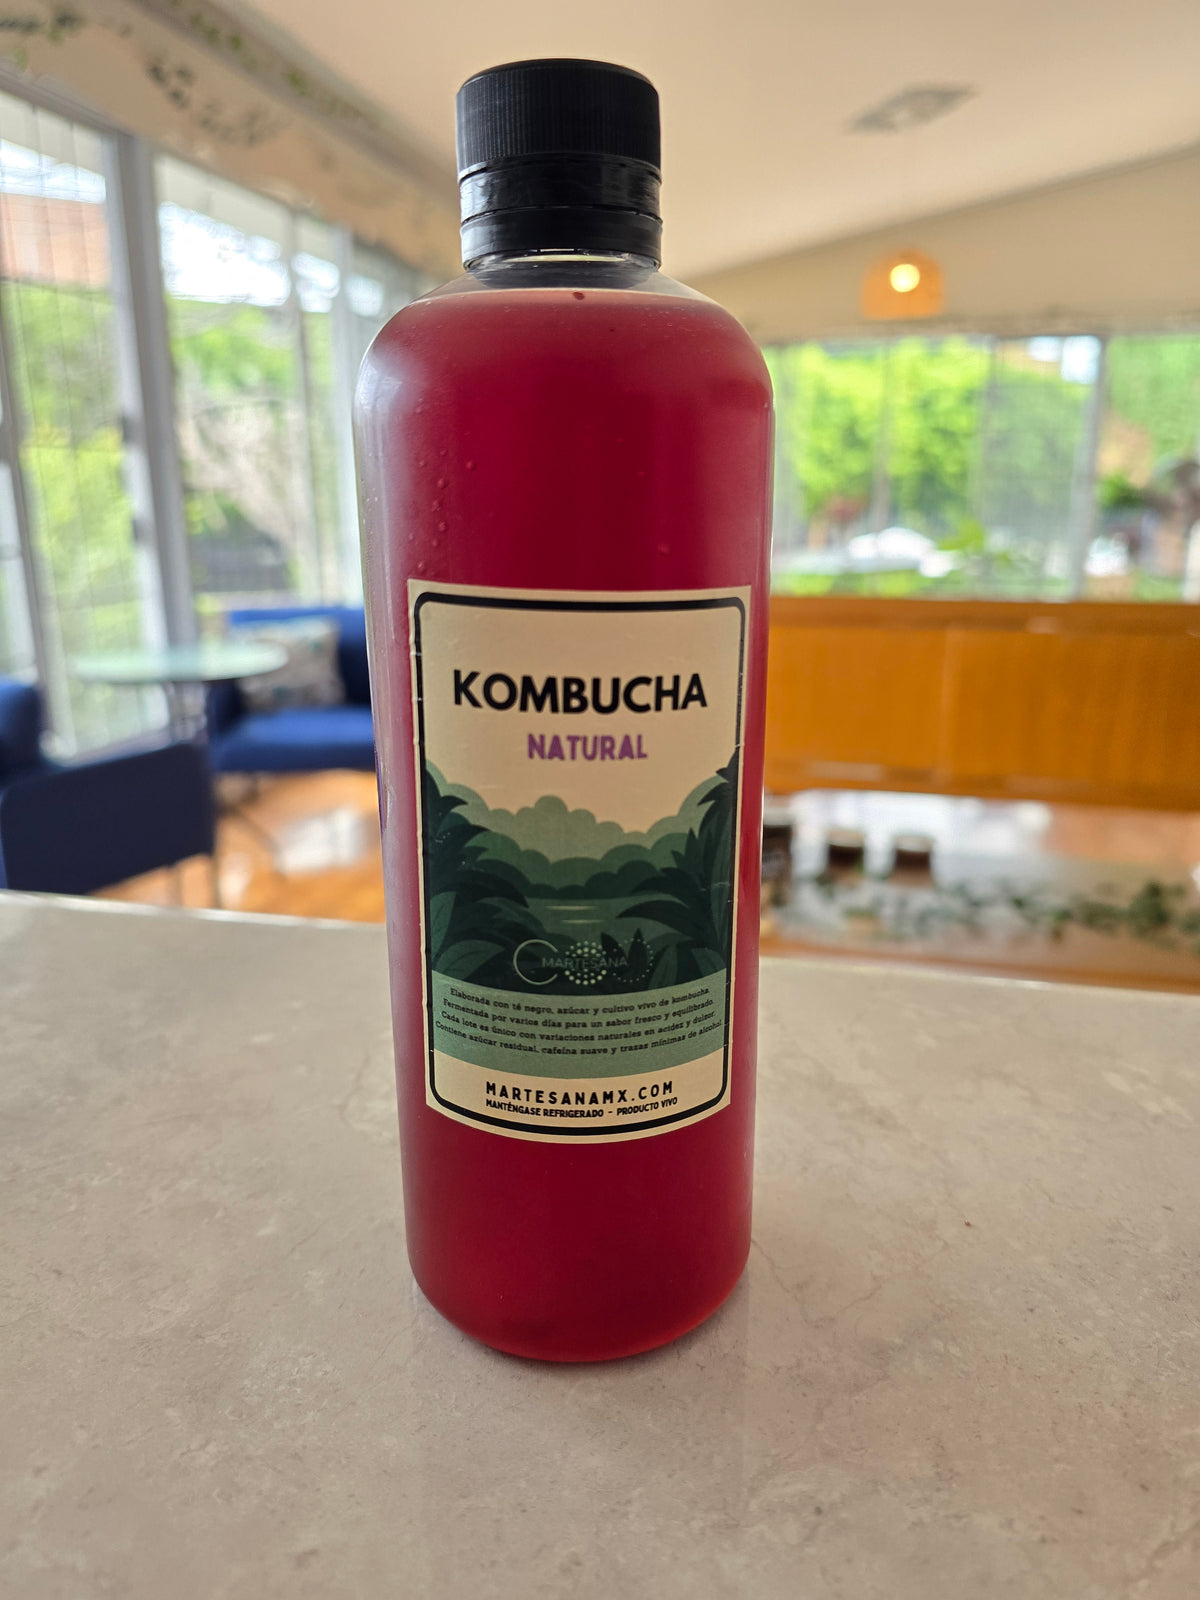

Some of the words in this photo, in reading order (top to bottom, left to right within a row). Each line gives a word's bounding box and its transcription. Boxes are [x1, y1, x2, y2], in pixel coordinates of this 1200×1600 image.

[453, 669, 708, 714] KOMBUCHA
[527, 733, 648, 761] NATURAL
[541, 956, 628, 969] MARTESANA
[443, 998, 489, 1019] Fermentada
[491, 1014, 507, 1022] por
[509, 1016, 539, 1026] varios
[541, 1019, 562, 1028] días
[565, 1021, 588, 1029] para
[606, 1018, 632, 1028] sabor
[634, 1015, 661, 1025] fresco
[450, 987, 491, 1006] Elaborada
[493, 999, 509, 1009] con
[512, 1003, 522, 1011] té
[557, 1006, 590, 1015] azúcar
[593, 1008, 599, 1016] y
[602, 1004, 635, 1014] cultivo
[637, 1001, 657, 1010] vivo
[659, 999, 669, 1007] de
[435, 1020, 467, 1038] Contiene
[469, 1034, 497, 1047] azúcar
[541, 1046, 578, 1055] cafeína
[611, 1047, 617, 1055] y
[620, 1043, 649, 1053] trazas
[651, 1034, 686, 1048] mínimas
[687, 1031, 697, 1039] de
[441, 1010, 460, 1024] Cada
[462, 1018, 478, 1028] lote
[480, 1024, 489, 1032] es
[492, 1025, 516, 1037] único
[597, 1030, 642, 1041] naturales
[644, 1028, 656, 1036] en
[658, 1022, 684, 1034] acidez
[685, 1020, 692, 1028] y
[486, 1081, 673, 1105] MARTESANAMX.COM
[486, 1099, 541, 1116] MANTÉNGASE
[543, 1108, 604, 1118] REFRIGERADO
[616, 1101, 659, 1116] PRODUCTO
[661, 1097, 678, 1107] VIVO
